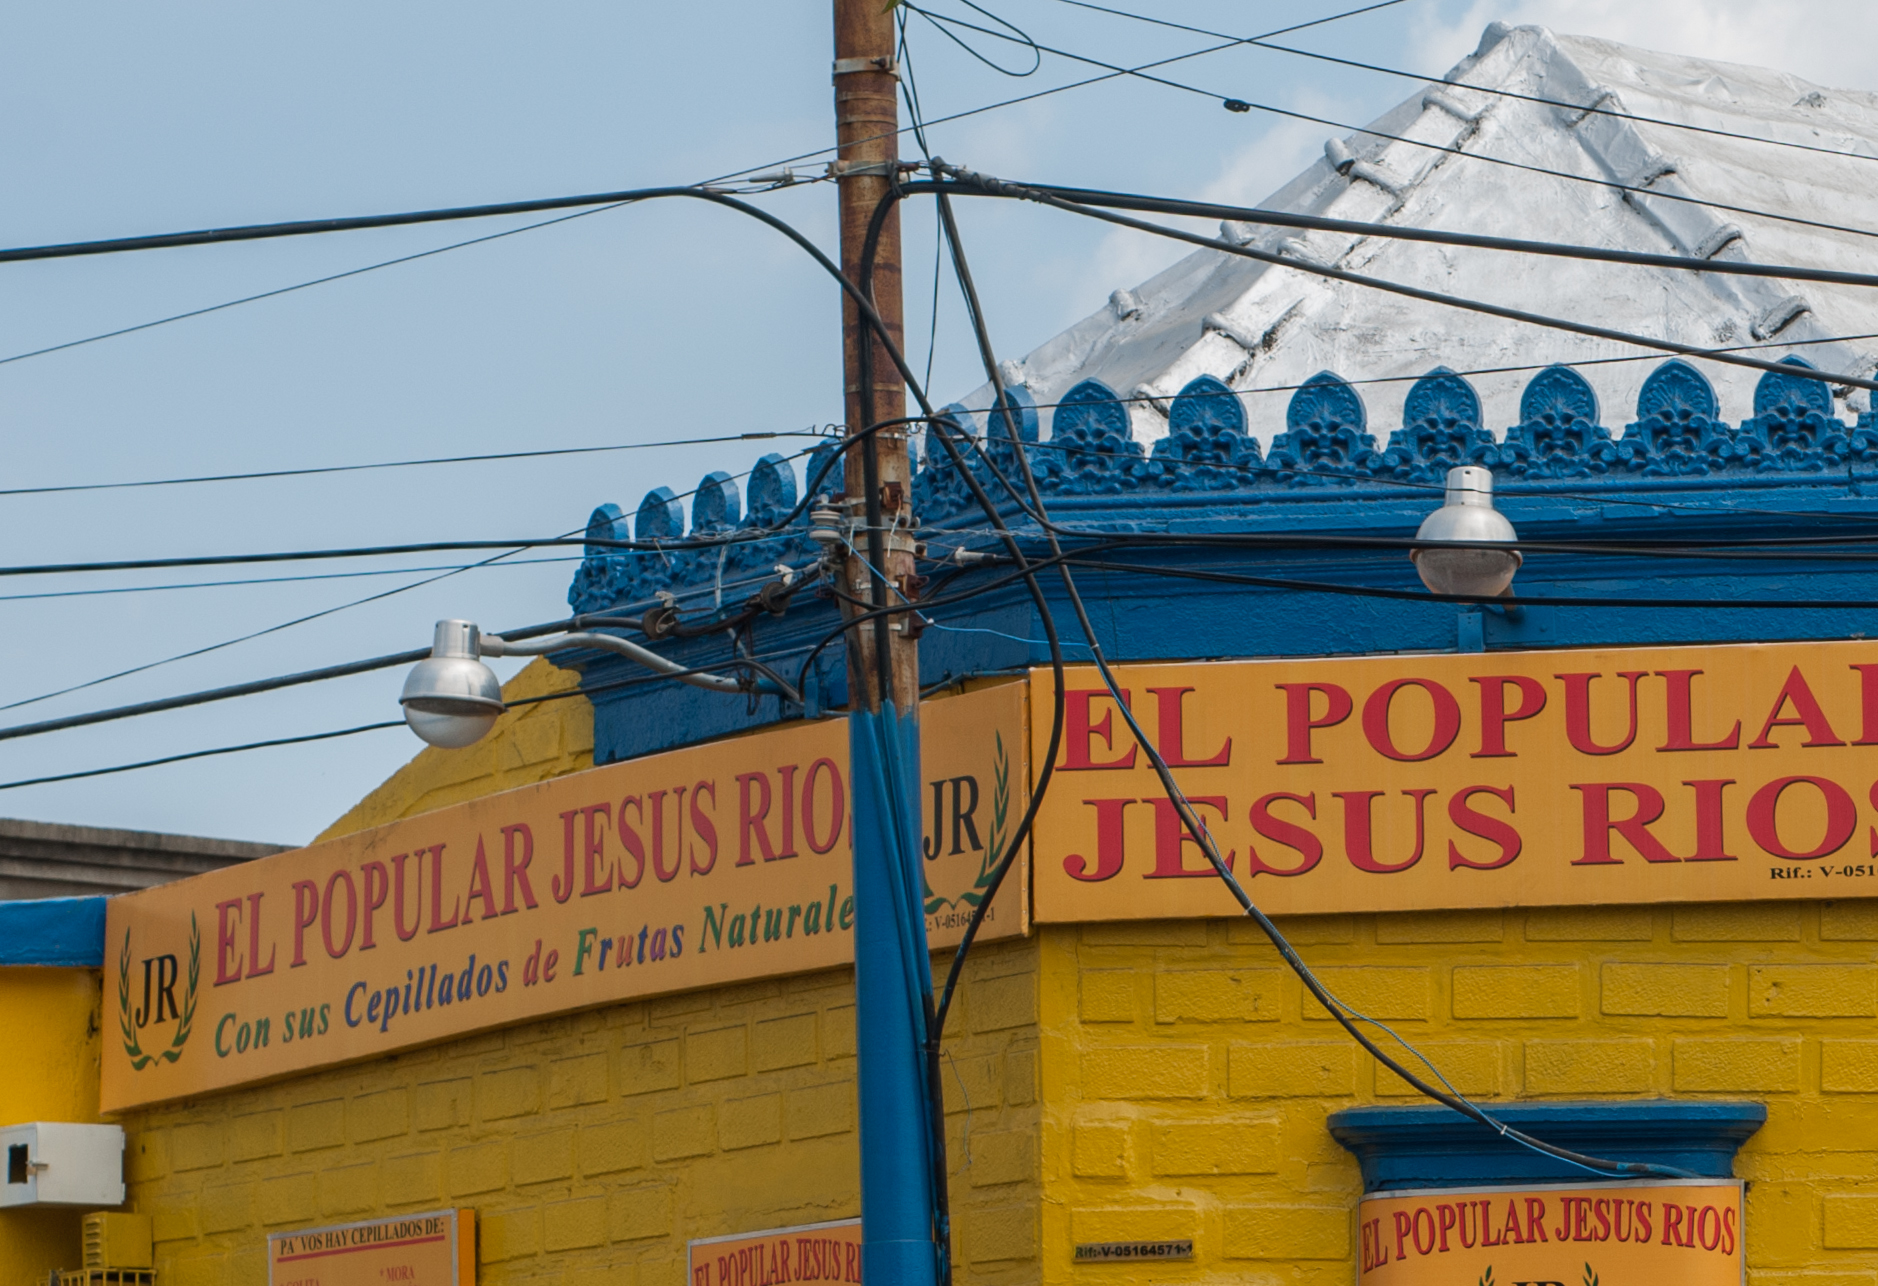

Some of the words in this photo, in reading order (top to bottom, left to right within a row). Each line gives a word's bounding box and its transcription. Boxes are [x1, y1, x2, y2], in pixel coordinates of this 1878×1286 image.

[1053, 686, 1232, 771] EL
[923, 775, 983, 861] JR
[1062, 784, 1522, 882] JESUS
[213, 892, 276, 987] EL
[291, 822, 539, 968] POPULAR
[551, 780, 719, 904] JESUS
[735, 756, 853, 867] RIO
[1770, 866, 1812, 880] Rif.:
[134, 950, 181, 1028] JR
[214, 1010, 270, 1058] Con
[283, 998, 331, 1043] sus
[344, 958, 509, 1033] Cepillados
[523, 939, 559, 988] de
[572, 920, 685, 976] Frutas
[698, 883, 855, 954] Naturale
[301, 1234, 322, 1251] VOS
[325, 1231, 348, 1249] HAY
[351, 1221, 422, 1245] CEPILLADOS
[425, 1218, 445, 1234] DE:
[387, 1265, 415, 1282] MORA
[794, 1238, 841, 1283] JESUS
[845, 1243, 862, 1284] RI
[1362, 1218, 1388, 1274] EL
[1393, 1198, 1548, 1261] POPULAR
[1555, 1197, 1653, 1244] JESUS
[1661, 1203, 1736, 1256] RIOS
